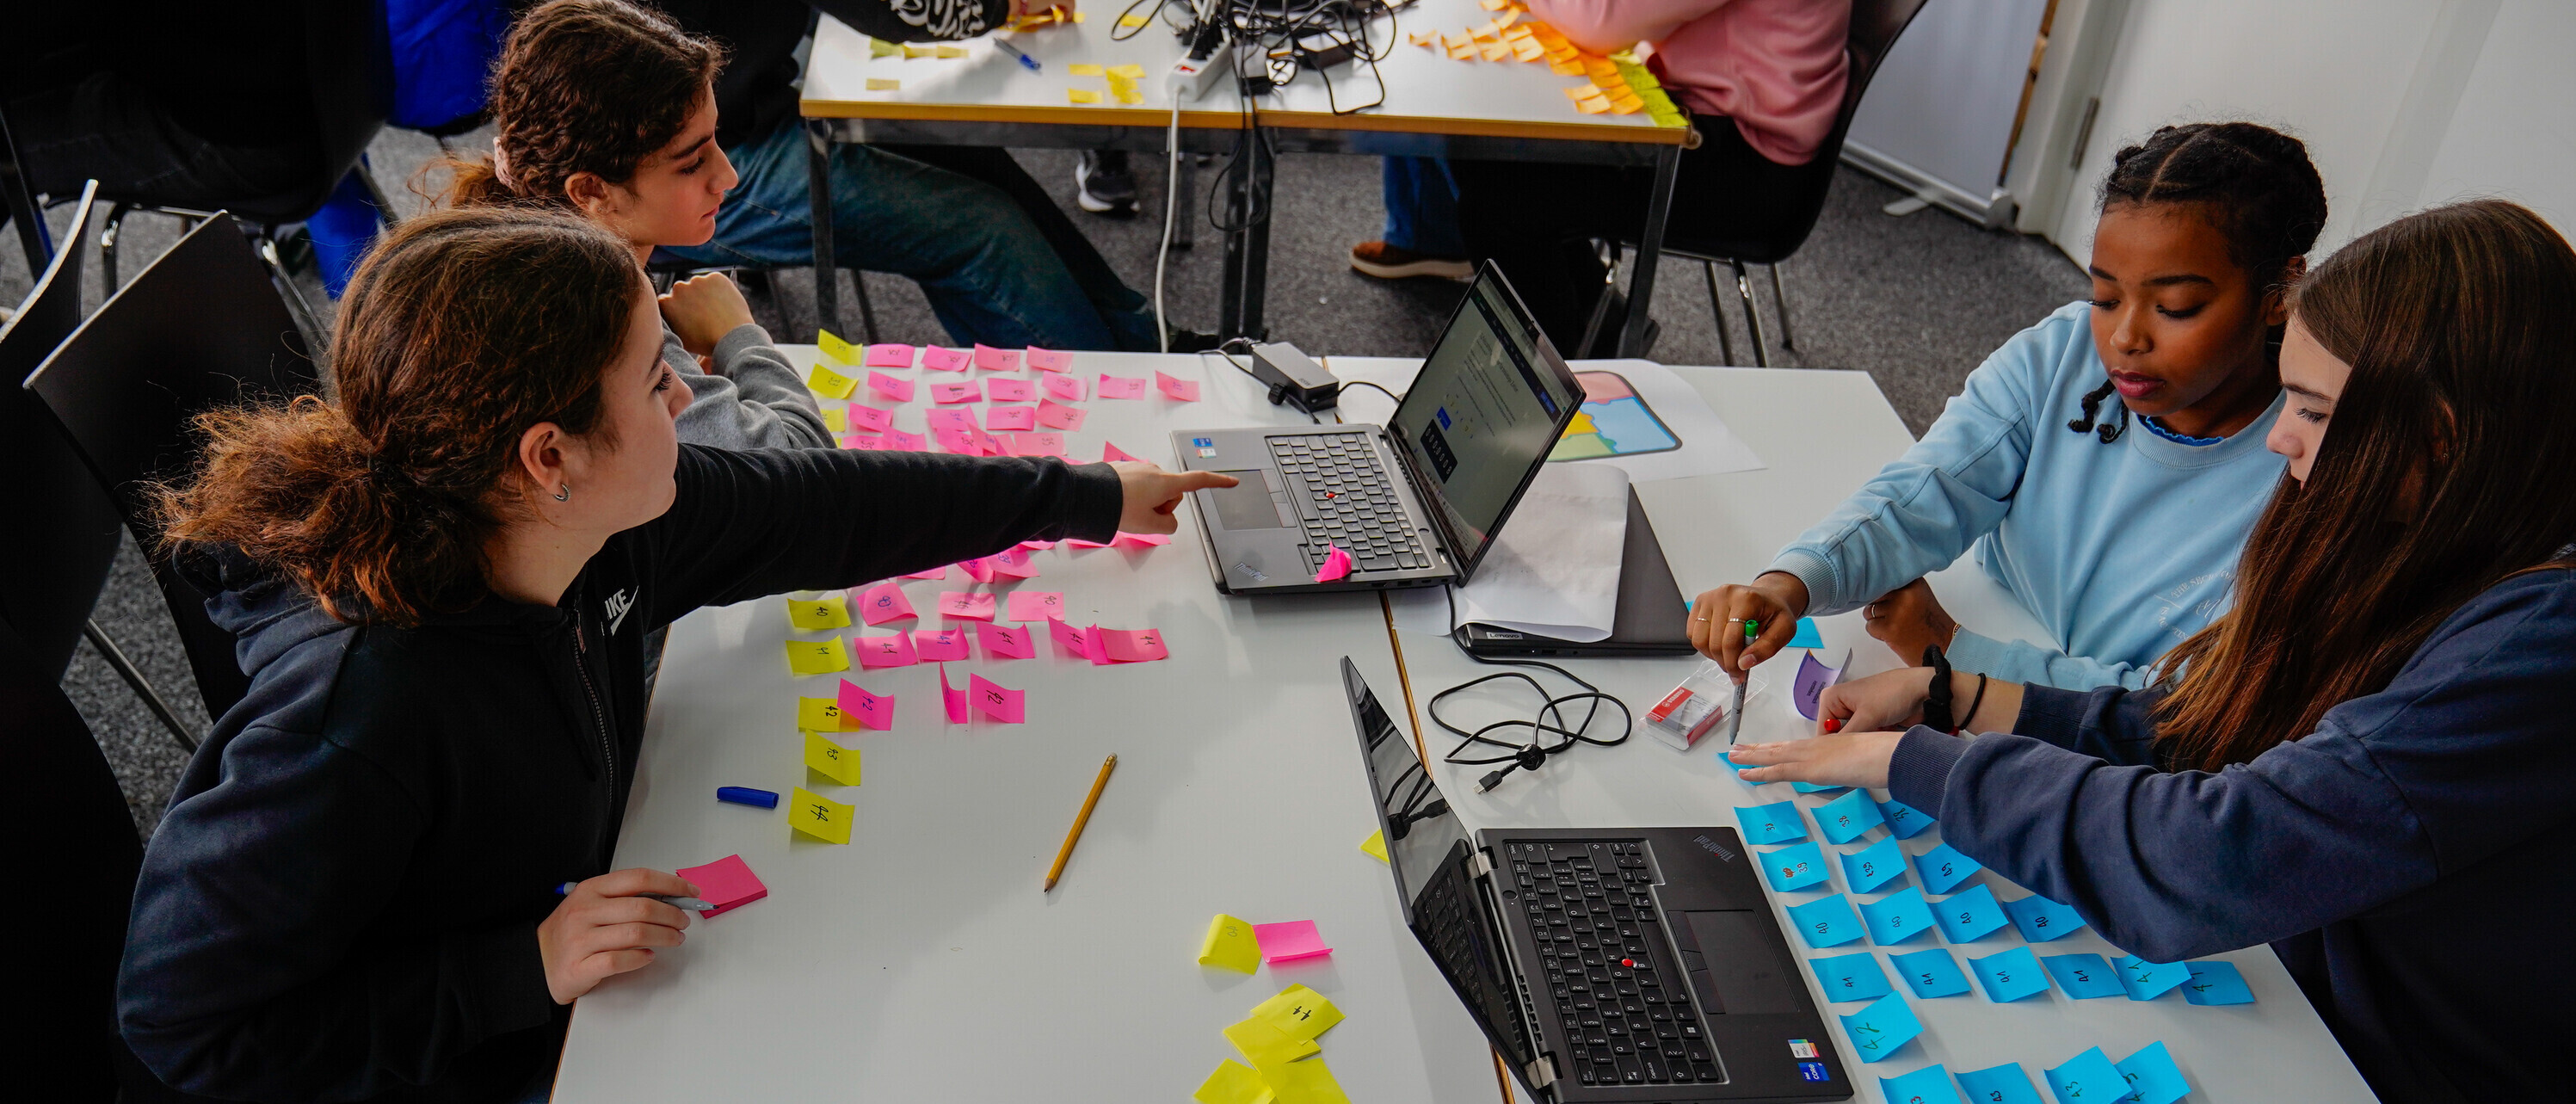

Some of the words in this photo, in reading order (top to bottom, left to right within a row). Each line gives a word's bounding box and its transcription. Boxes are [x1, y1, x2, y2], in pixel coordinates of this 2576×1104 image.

[1234, 563, 1268, 581] ThinkPad
[817, 607, 828, 616] 40
[937, 636, 951, 645] 41
[997, 632, 1014, 645] 41
[1069, 633, 1084, 645] 41
[1140, 636, 1156, 645] 41
[883, 644, 897, 654] 41
[862, 696, 874, 711] 42
[986, 690, 1004, 705] 42
[825, 706, 838, 717] 42
[827, 748, 838, 761] 43
[810, 804, 829, 822] 44
[1893, 808, 1909, 822] 38
[1839, 816, 1850, 827] 38
[1693, 836, 1735, 862] ThinkPad
[1796, 862, 1808, 873] 39
[1891, 916, 1901, 928] 40
[1960, 912, 1971, 924] 40
[2035, 916, 2049, 928] 40
[1815, 922, 1829, 934] 40
[1842, 977, 1853, 987] 41
[1921, 973, 1934, 984] 41
[1996, 971, 2010, 983] 41
[2076, 970, 2089, 982] 41
[1856, 1022, 1886, 1050] 42
[1809, 1064, 1820, 1080] CORE
[1990, 1090, 2002, 1101] 43
[2065, 1082, 2081, 1097] 43
